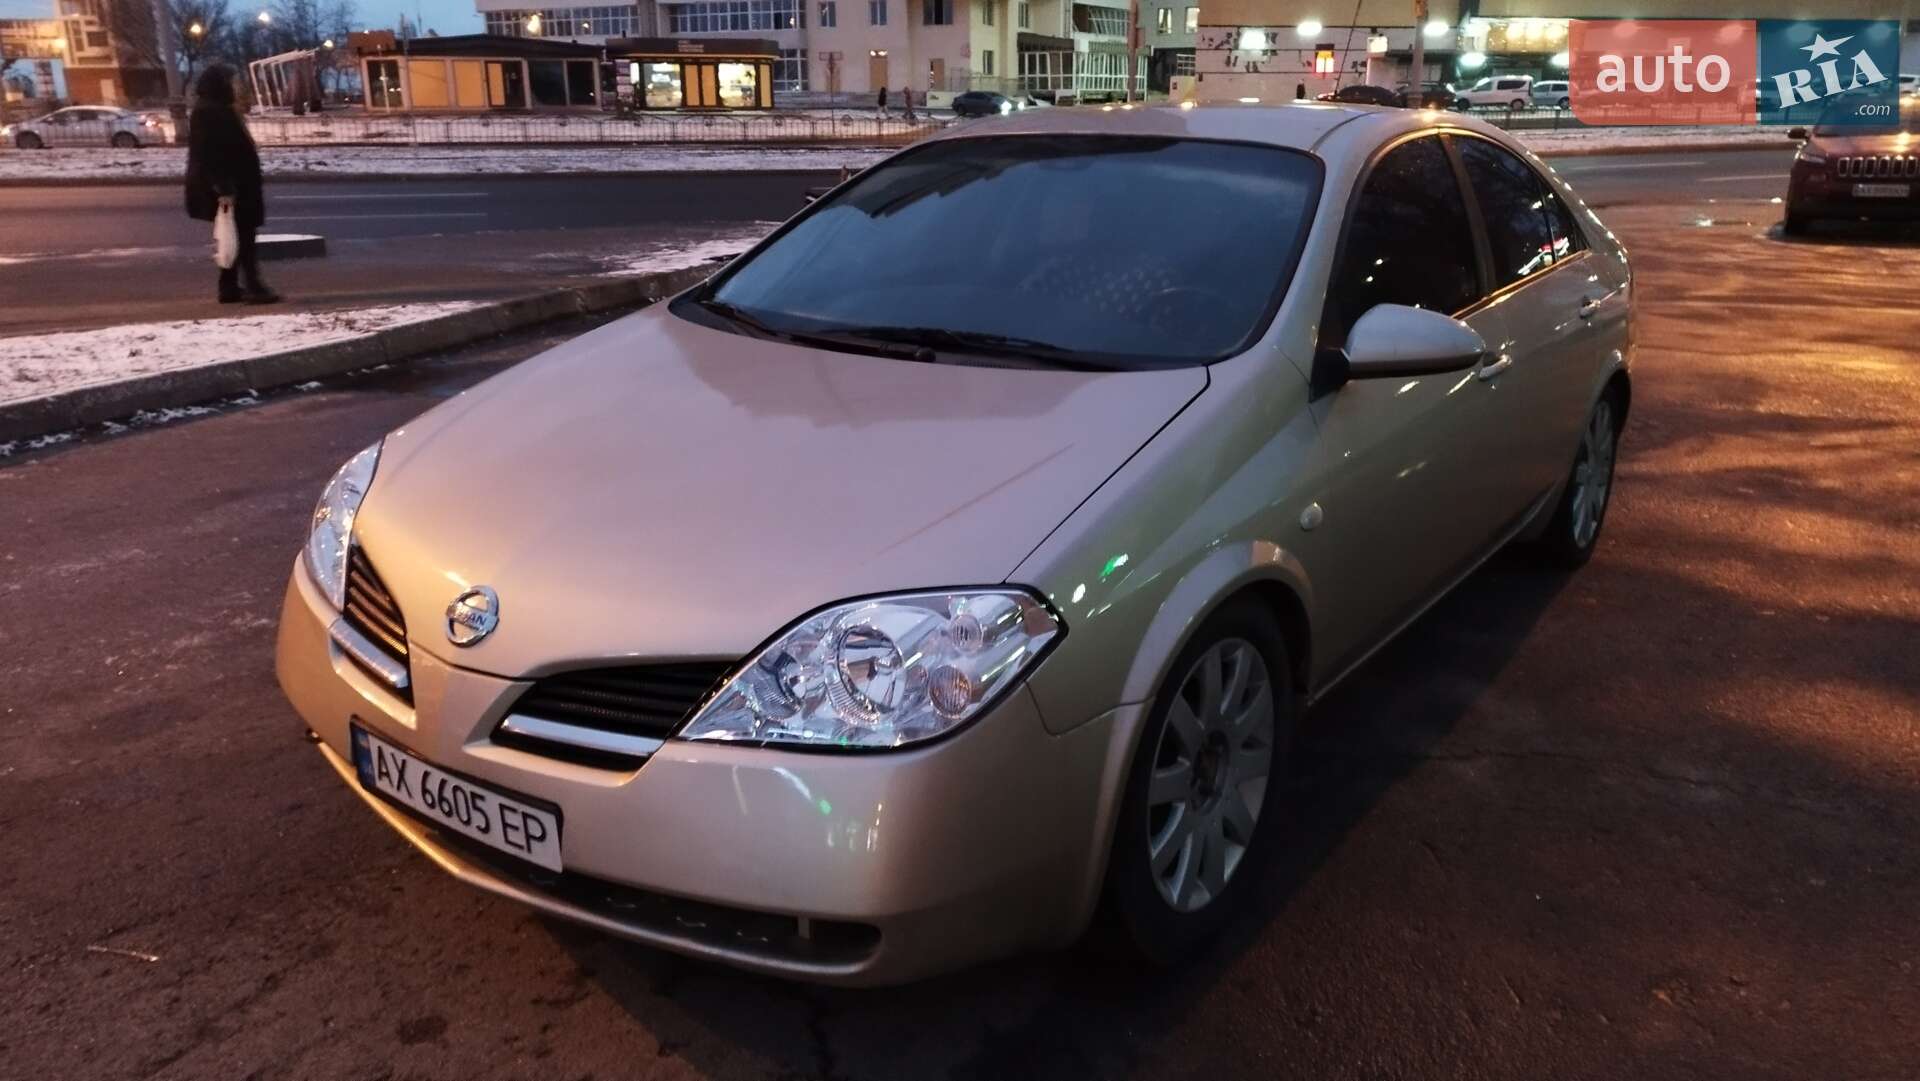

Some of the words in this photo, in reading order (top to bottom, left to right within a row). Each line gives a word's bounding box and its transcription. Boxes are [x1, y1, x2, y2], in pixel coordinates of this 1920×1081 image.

[377, 745, 412, 799] AX
[421, 771, 491, 834] 6605
[498, 803, 547, 853] EP
